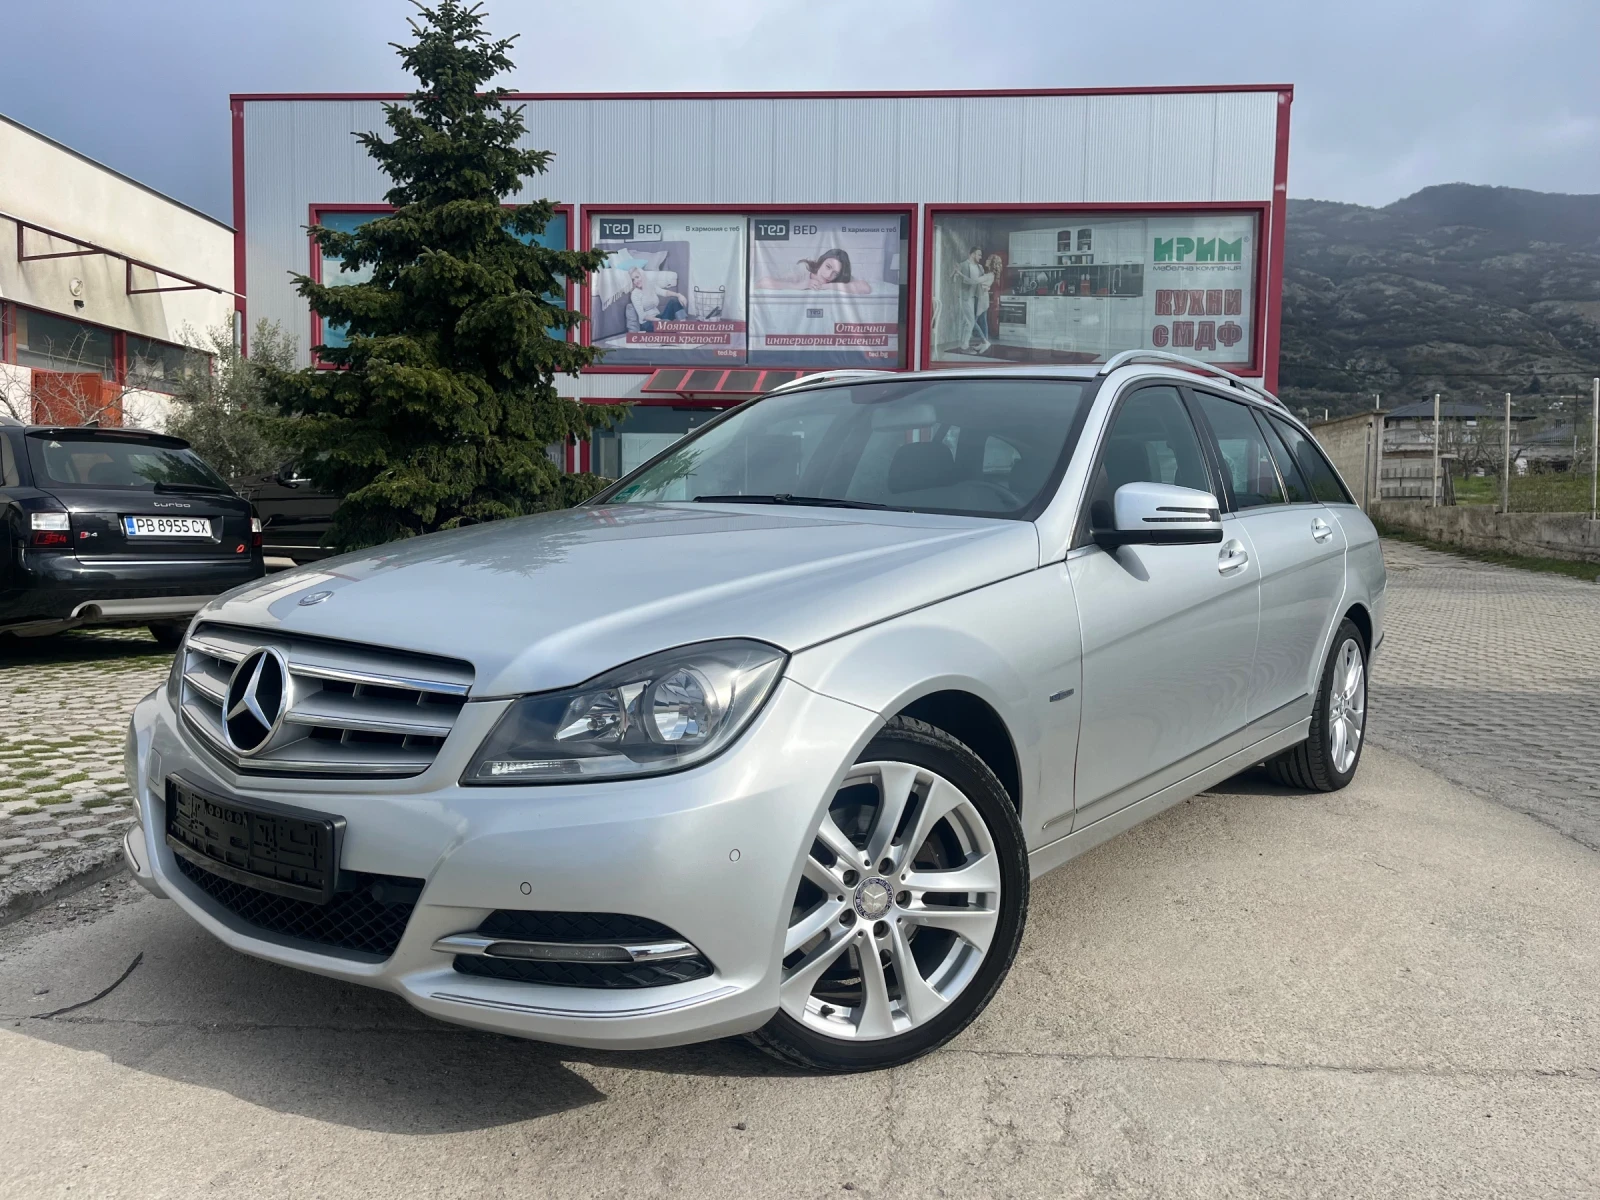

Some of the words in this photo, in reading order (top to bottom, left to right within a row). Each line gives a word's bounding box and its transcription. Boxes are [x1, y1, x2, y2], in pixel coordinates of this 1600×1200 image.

[637, 224, 662, 234] BED
[793, 225, 818, 235] BED
[1153, 236, 1243, 262] ИРИМ
[1155, 289, 1242, 316] КУХНИ
[656, 321, 695, 331] Моята
[697, 322, 735, 331] спалня
[835, 323, 886, 333] Отлични
[639, 335, 676, 343] моята
[678, 334, 728, 346] крепост!
[767, 334, 833, 347] интериорни
[835, 334, 885, 348] решения!
[1172, 320, 1243, 351] МДФ
[717, 349, 738, 357] ted.bg
[136, 518, 156, 533] PB
[158, 519, 190, 533] 8955
[191, 520, 209, 534] CX
